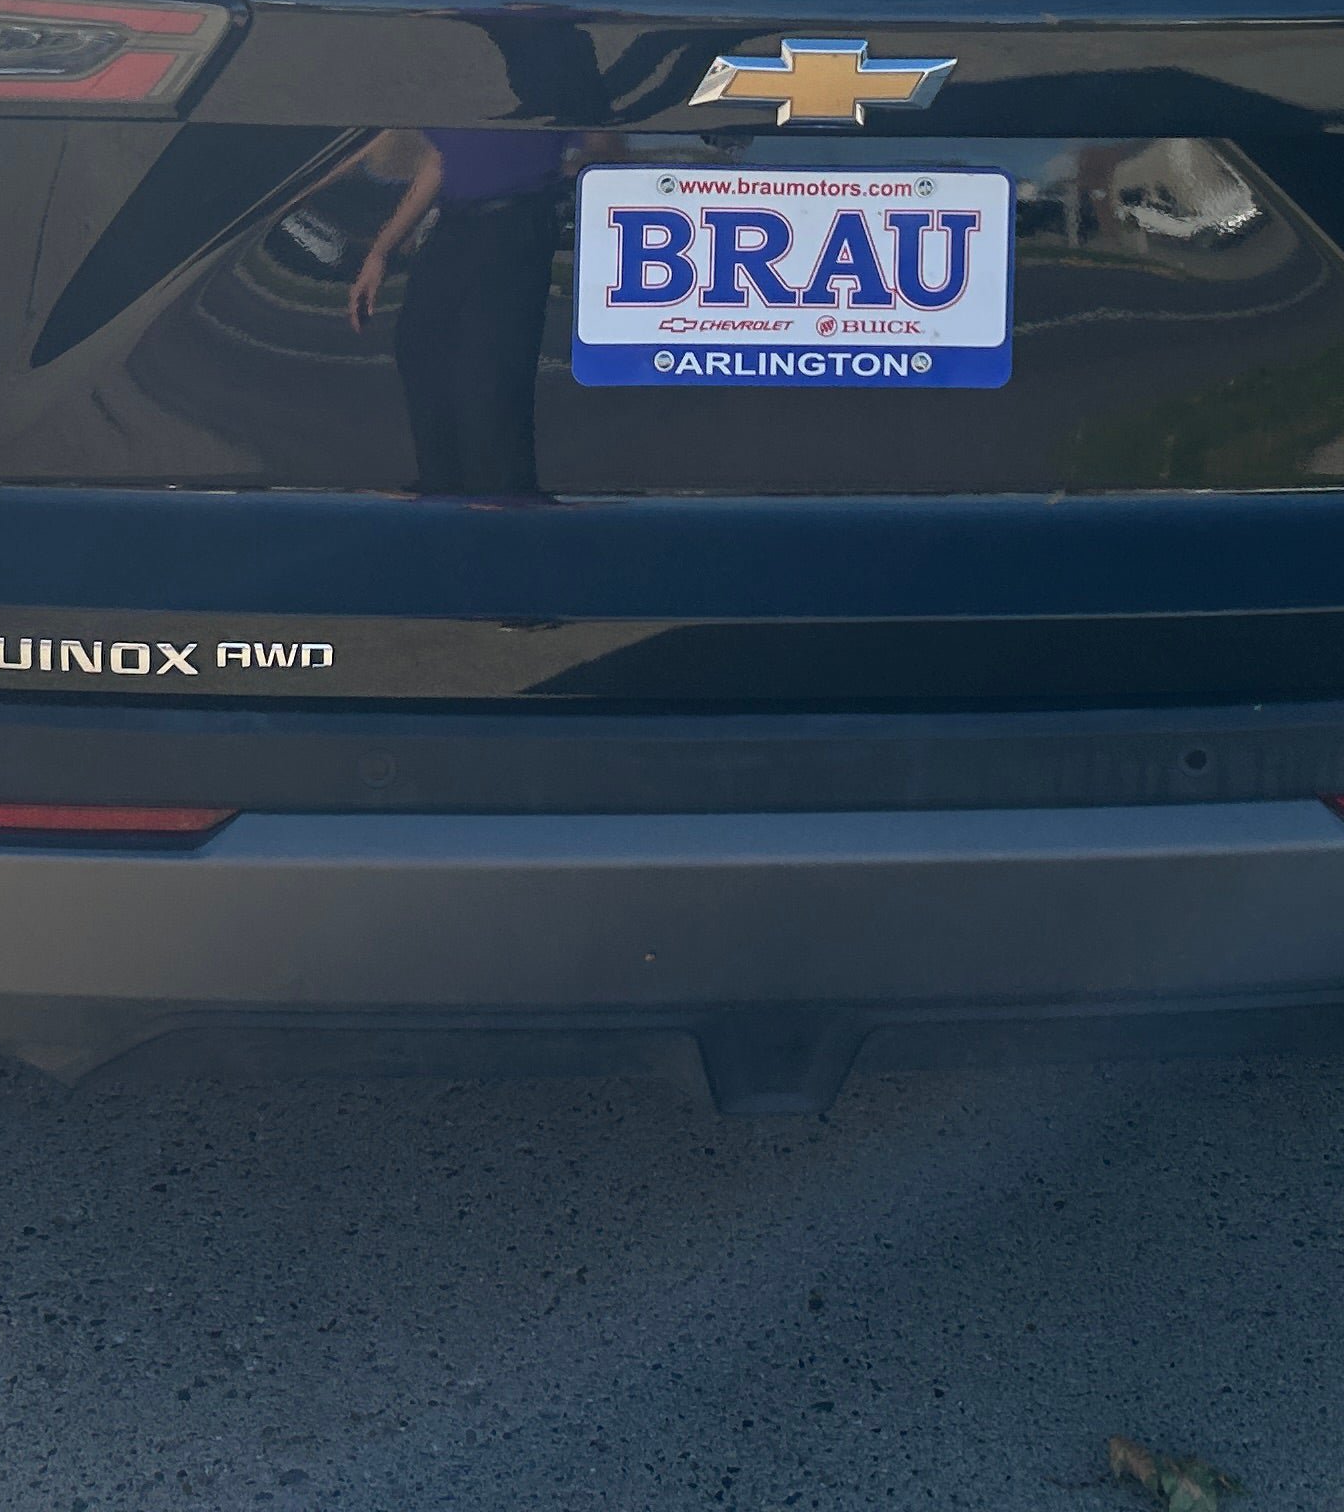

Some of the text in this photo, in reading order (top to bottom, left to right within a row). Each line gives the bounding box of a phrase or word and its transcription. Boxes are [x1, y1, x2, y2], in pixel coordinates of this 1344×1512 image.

[678, 177, 913, 197] www.braumotors.com
[605, 206, 982, 312] BRAU
[699, 319, 922, 335] CHEVROLET BUICK
[674, 350, 909, 377] ARLINGTON
[216, 641, 334, 669] AWD
